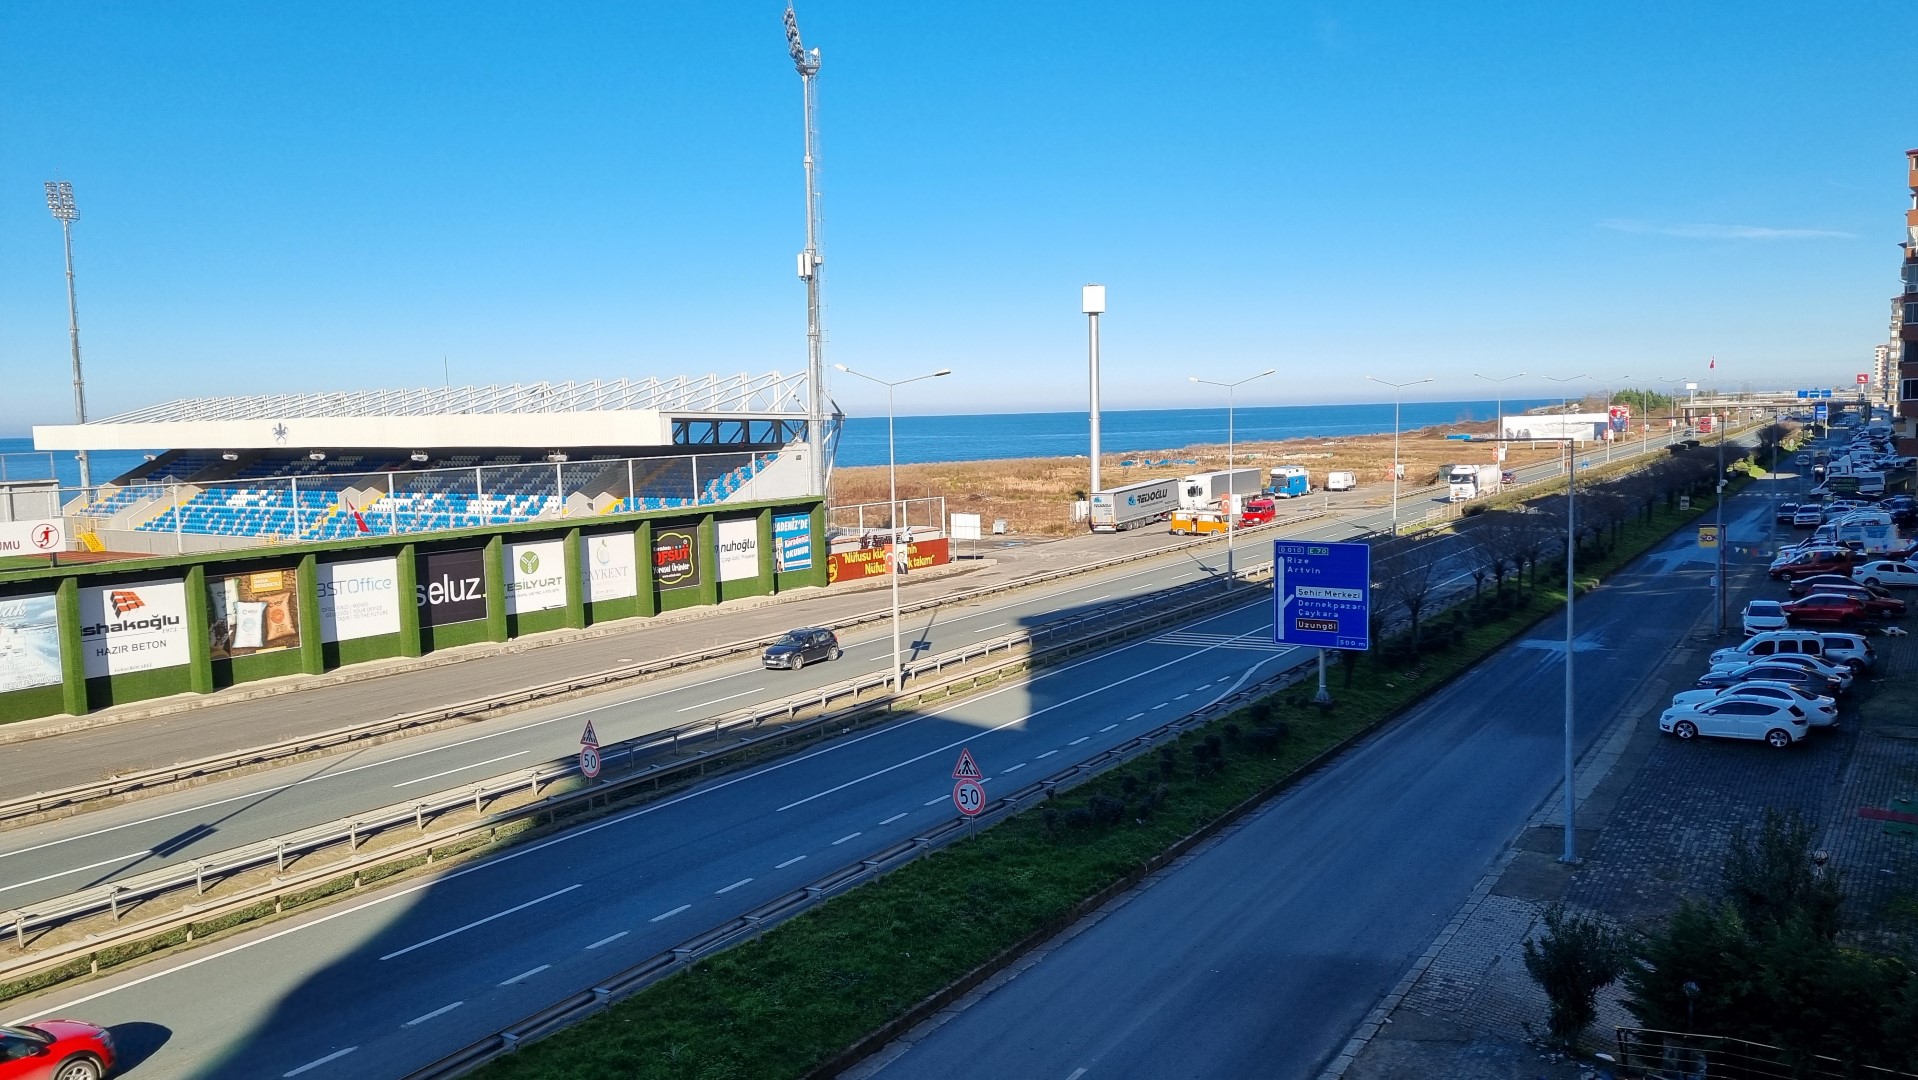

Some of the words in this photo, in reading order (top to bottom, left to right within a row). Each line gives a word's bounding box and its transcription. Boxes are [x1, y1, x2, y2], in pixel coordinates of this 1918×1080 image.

[720, 538, 756, 552] nuhoğlu
[786, 546, 809, 558] OKUNUR
[1288, 566, 1320, 574] Artvin
[1324, 590, 1360, 598] Merkezi
[80, 612, 180, 638] ishakoğlu
[1298, 621, 1336, 630] Uzungöl
[96, 644, 129, 657] HAZIR
[132, 640, 167, 652] BETON
[584, 754, 596, 769] 50
[960, 788, 979, 806] 50
